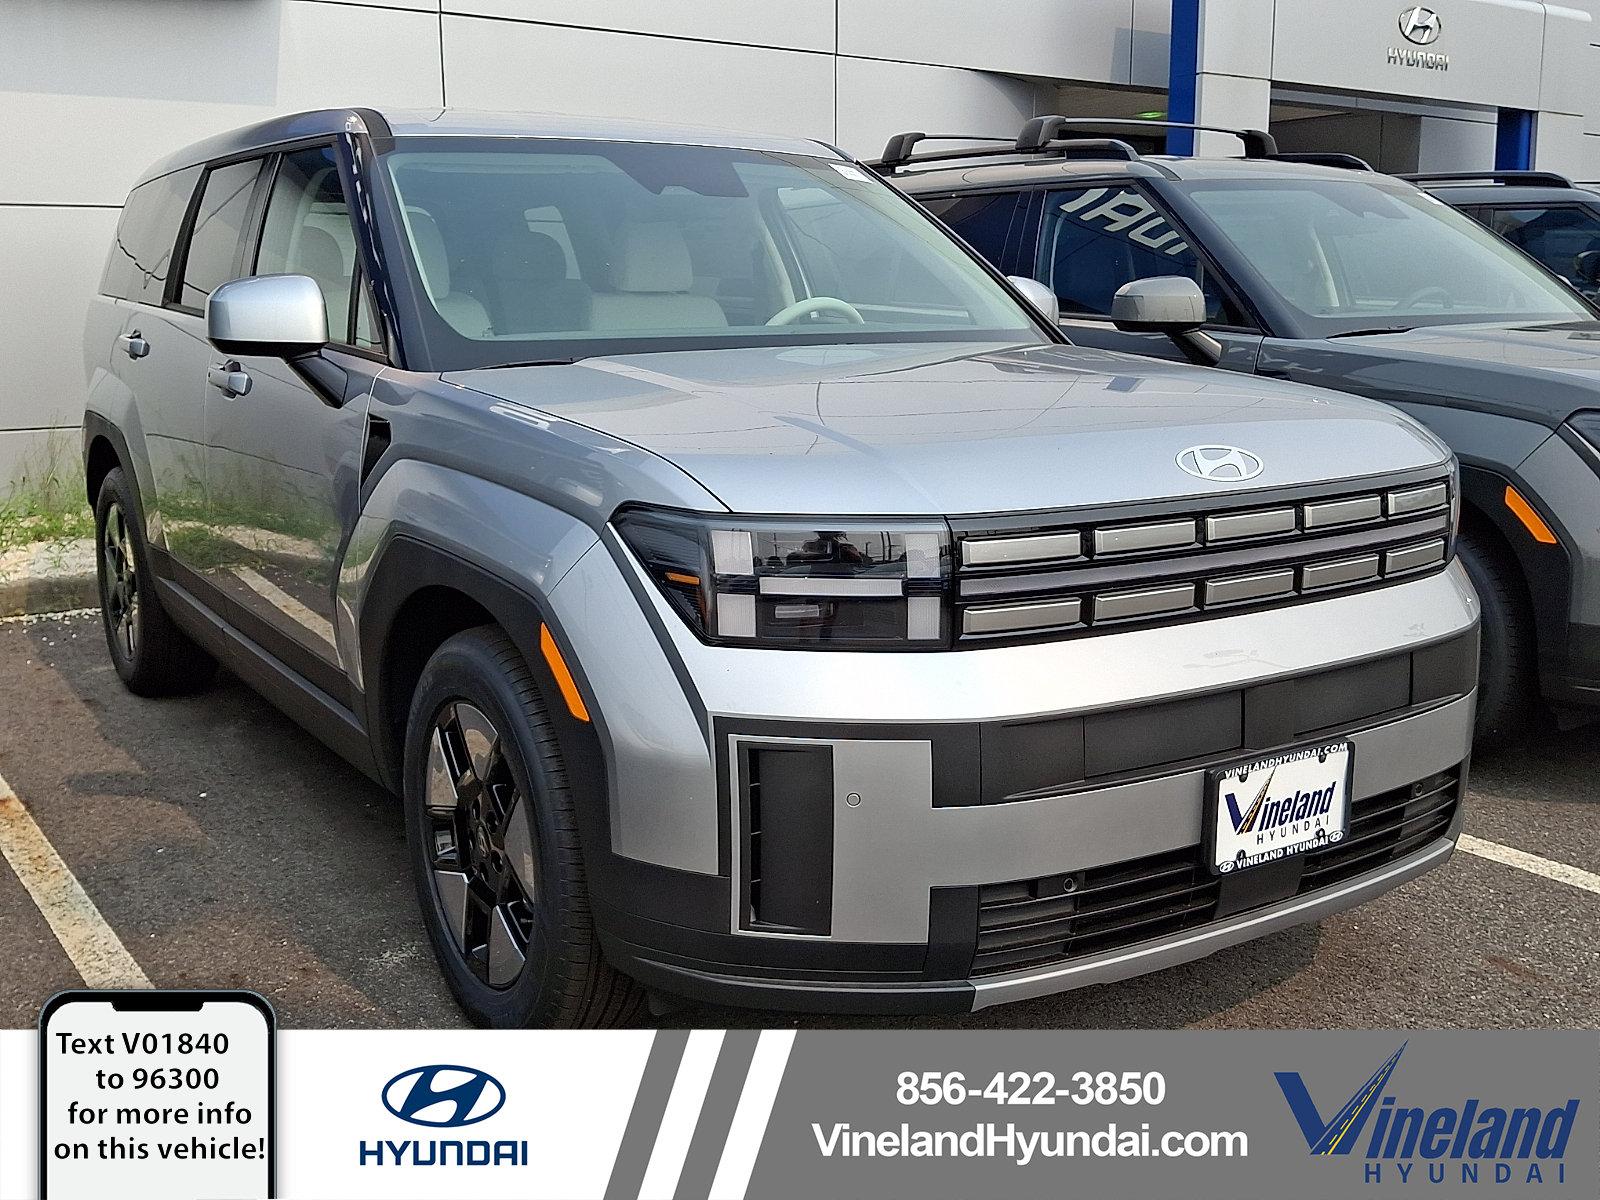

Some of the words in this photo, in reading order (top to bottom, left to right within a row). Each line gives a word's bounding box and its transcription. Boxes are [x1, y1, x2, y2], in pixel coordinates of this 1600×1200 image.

[1387, 47, 1449, 72] HYUNDAI
[1224, 742, 1348, 780] VINELANDHYUNDAI.COM
[1225, 765, 1337, 836] Vineland
[1256, 815, 1330, 845] HYUNDAI
[1236, 848, 1284, 869] VINELAND
[1286, 837, 1329, 856] HYUNDAI
